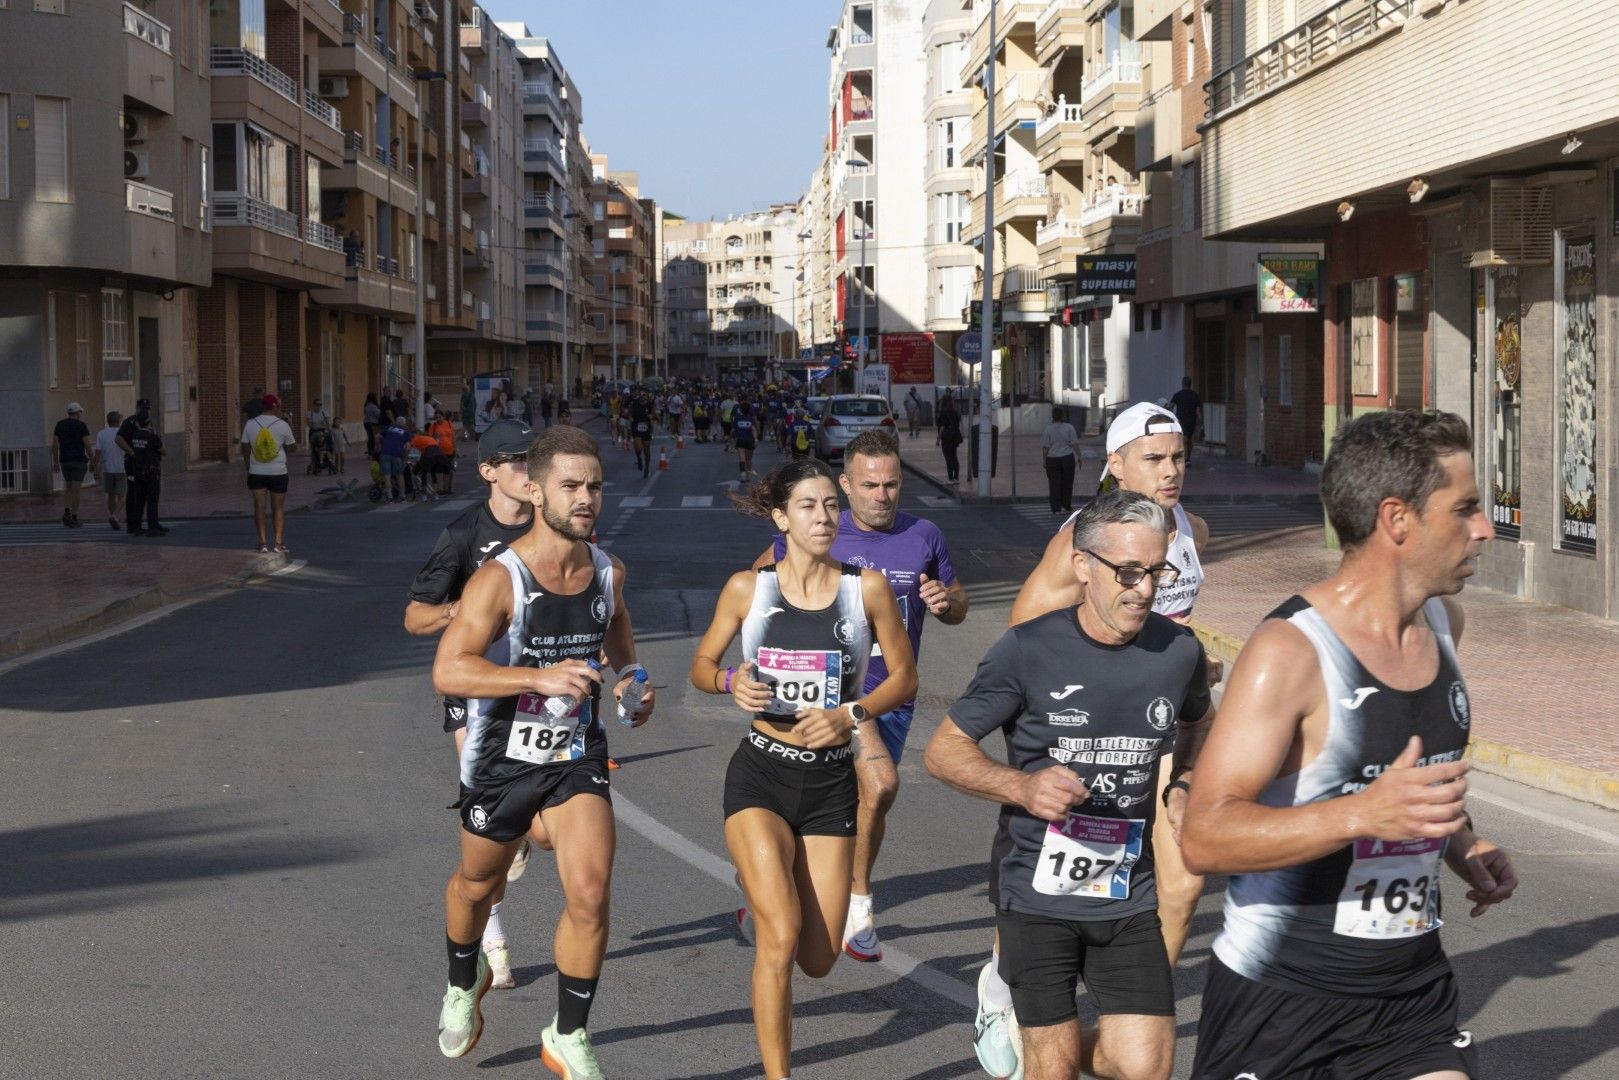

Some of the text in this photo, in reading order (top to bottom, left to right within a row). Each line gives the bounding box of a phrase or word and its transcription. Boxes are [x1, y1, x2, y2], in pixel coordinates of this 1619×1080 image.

[531, 636, 556, 646] CLUB
[826, 676, 839, 706] 7 KM
[518, 726, 571, 750] 182
[1059, 737, 1092, 750] CLUB
[768, 742, 817, 762] PRO
[1049, 748, 1095, 763] PUETO
[1090, 773, 1117, 793] AS
[1048, 850, 1115, 881] 187
[1113, 873, 1127, 886] 7
[1354, 876, 1429, 914] 163
